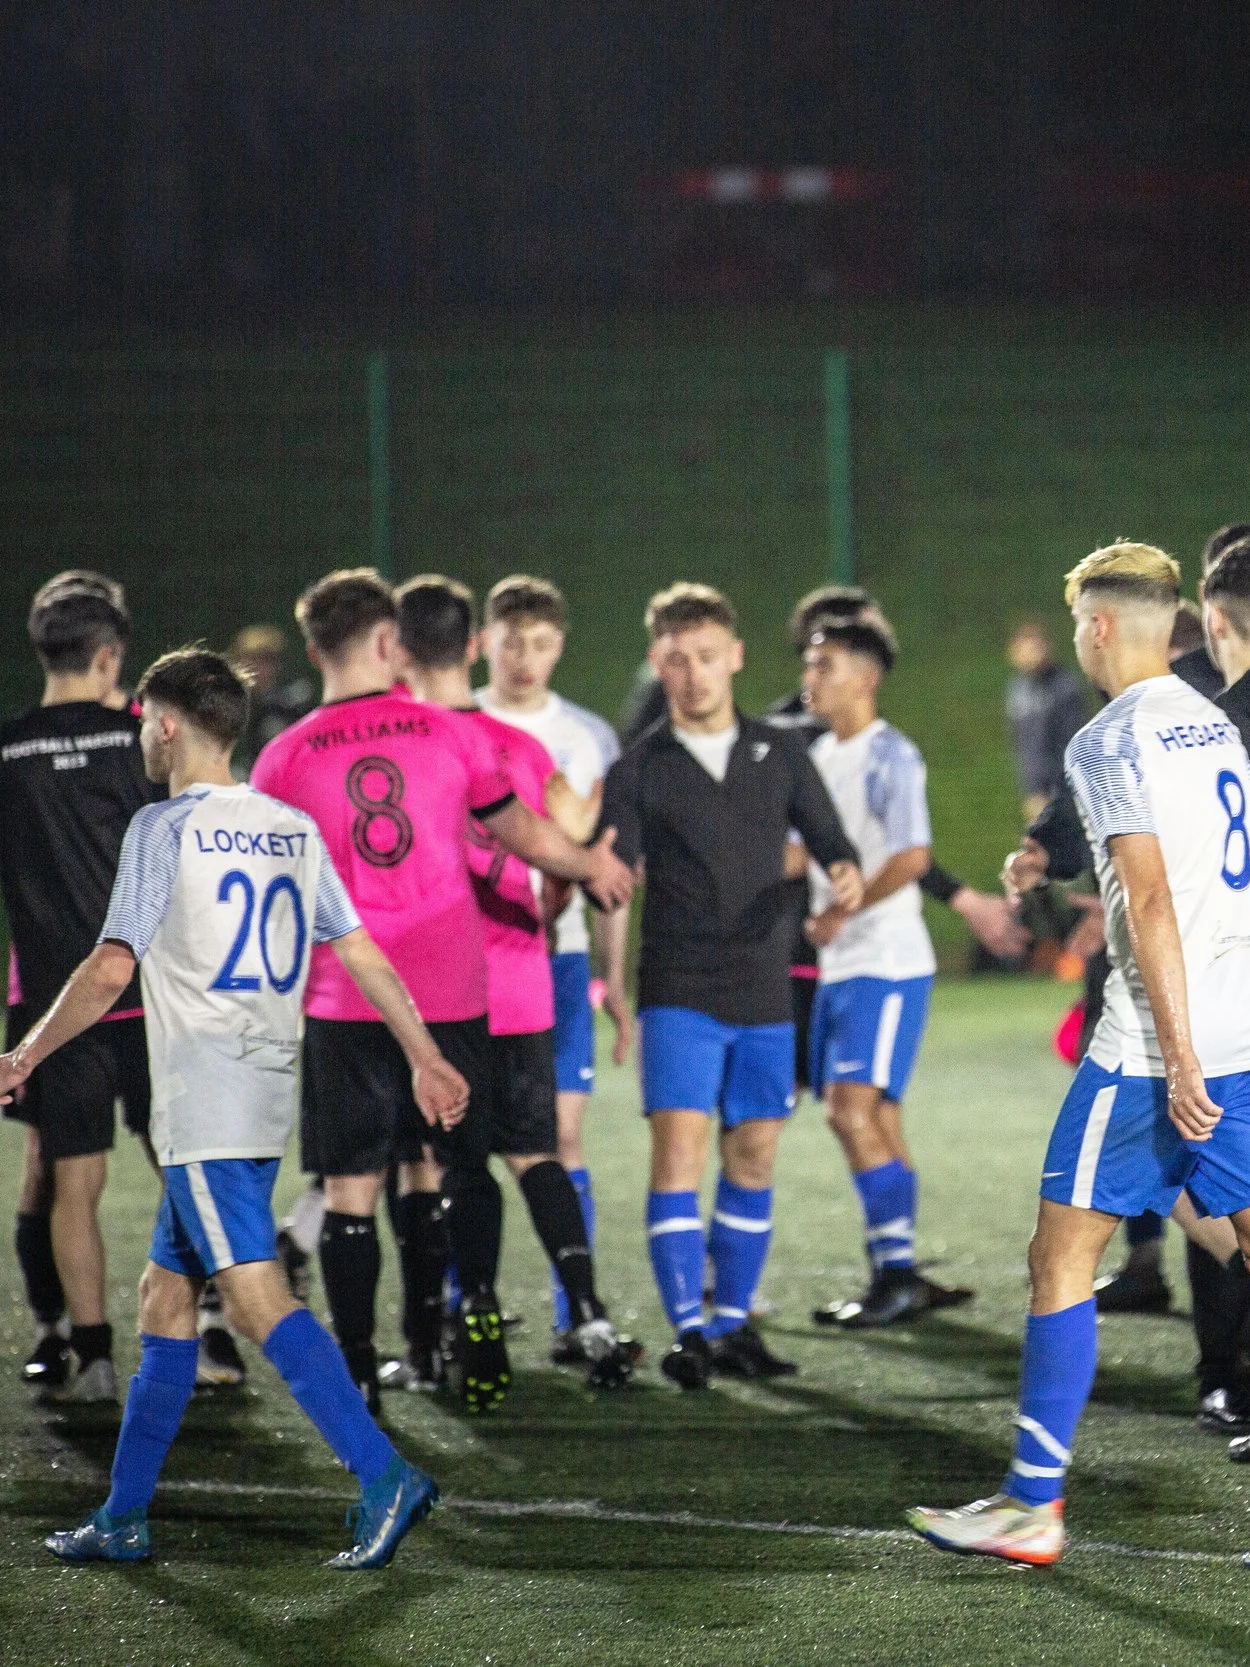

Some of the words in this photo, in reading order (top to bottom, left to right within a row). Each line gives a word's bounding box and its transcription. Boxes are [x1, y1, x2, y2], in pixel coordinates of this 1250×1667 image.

[307, 720, 431, 750] WILLIAMS
[195, 829, 308, 857] LOCKETT
[345, 755, 414, 868] 8
[206, 868, 307, 996] 20
